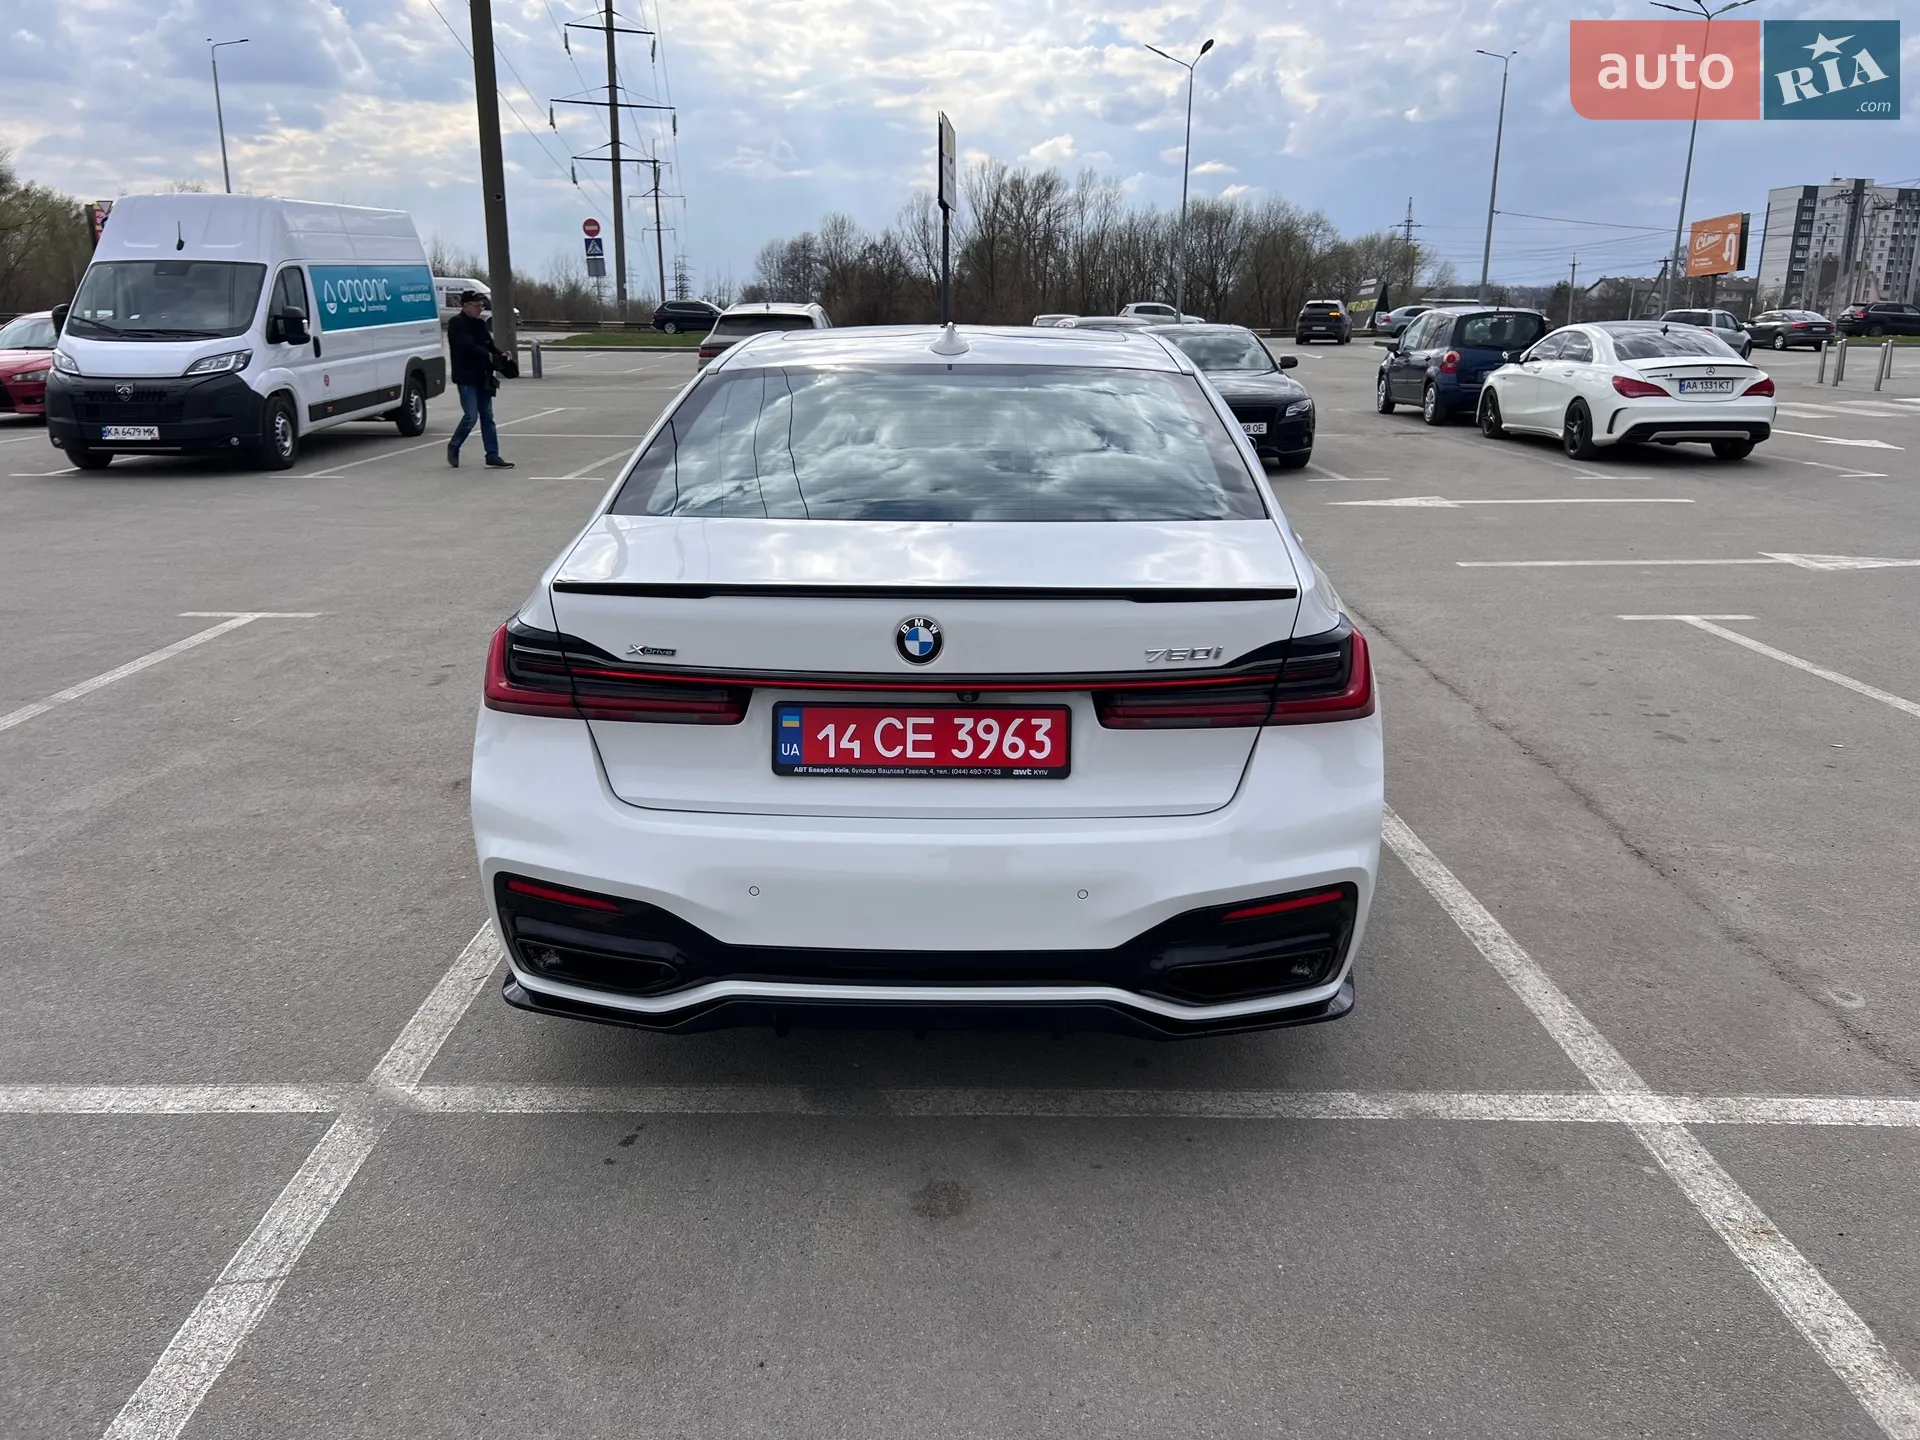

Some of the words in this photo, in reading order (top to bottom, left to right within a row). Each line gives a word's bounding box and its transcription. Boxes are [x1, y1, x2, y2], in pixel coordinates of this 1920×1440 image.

[337, 278, 391, 312] organic
[1686, 381, 1698, 390] AA
[1700, 381, 1717, 390] 1331
[1718, 381, 1731, 390] KT
[107, 428, 120, 437] KA
[121, 427, 141, 437] 6479
[1252, 424, 1264, 433] OE
[900, 618, 940, 634] BMW
[1145, 646, 1224, 663] 750i
[816, 723, 861, 759] 14
[874, 716, 936, 759] CE
[951, 717, 1052, 760] 3963
[781, 743, 800, 757] UA
[851, 767, 877, 775] бульвар
[877, 767, 905, 775] Вацлава
[951, 768, 968, 776] (044)
[969, 768, 1001, 776] 490-77-33
[1012, 768, 1032, 776] awt
